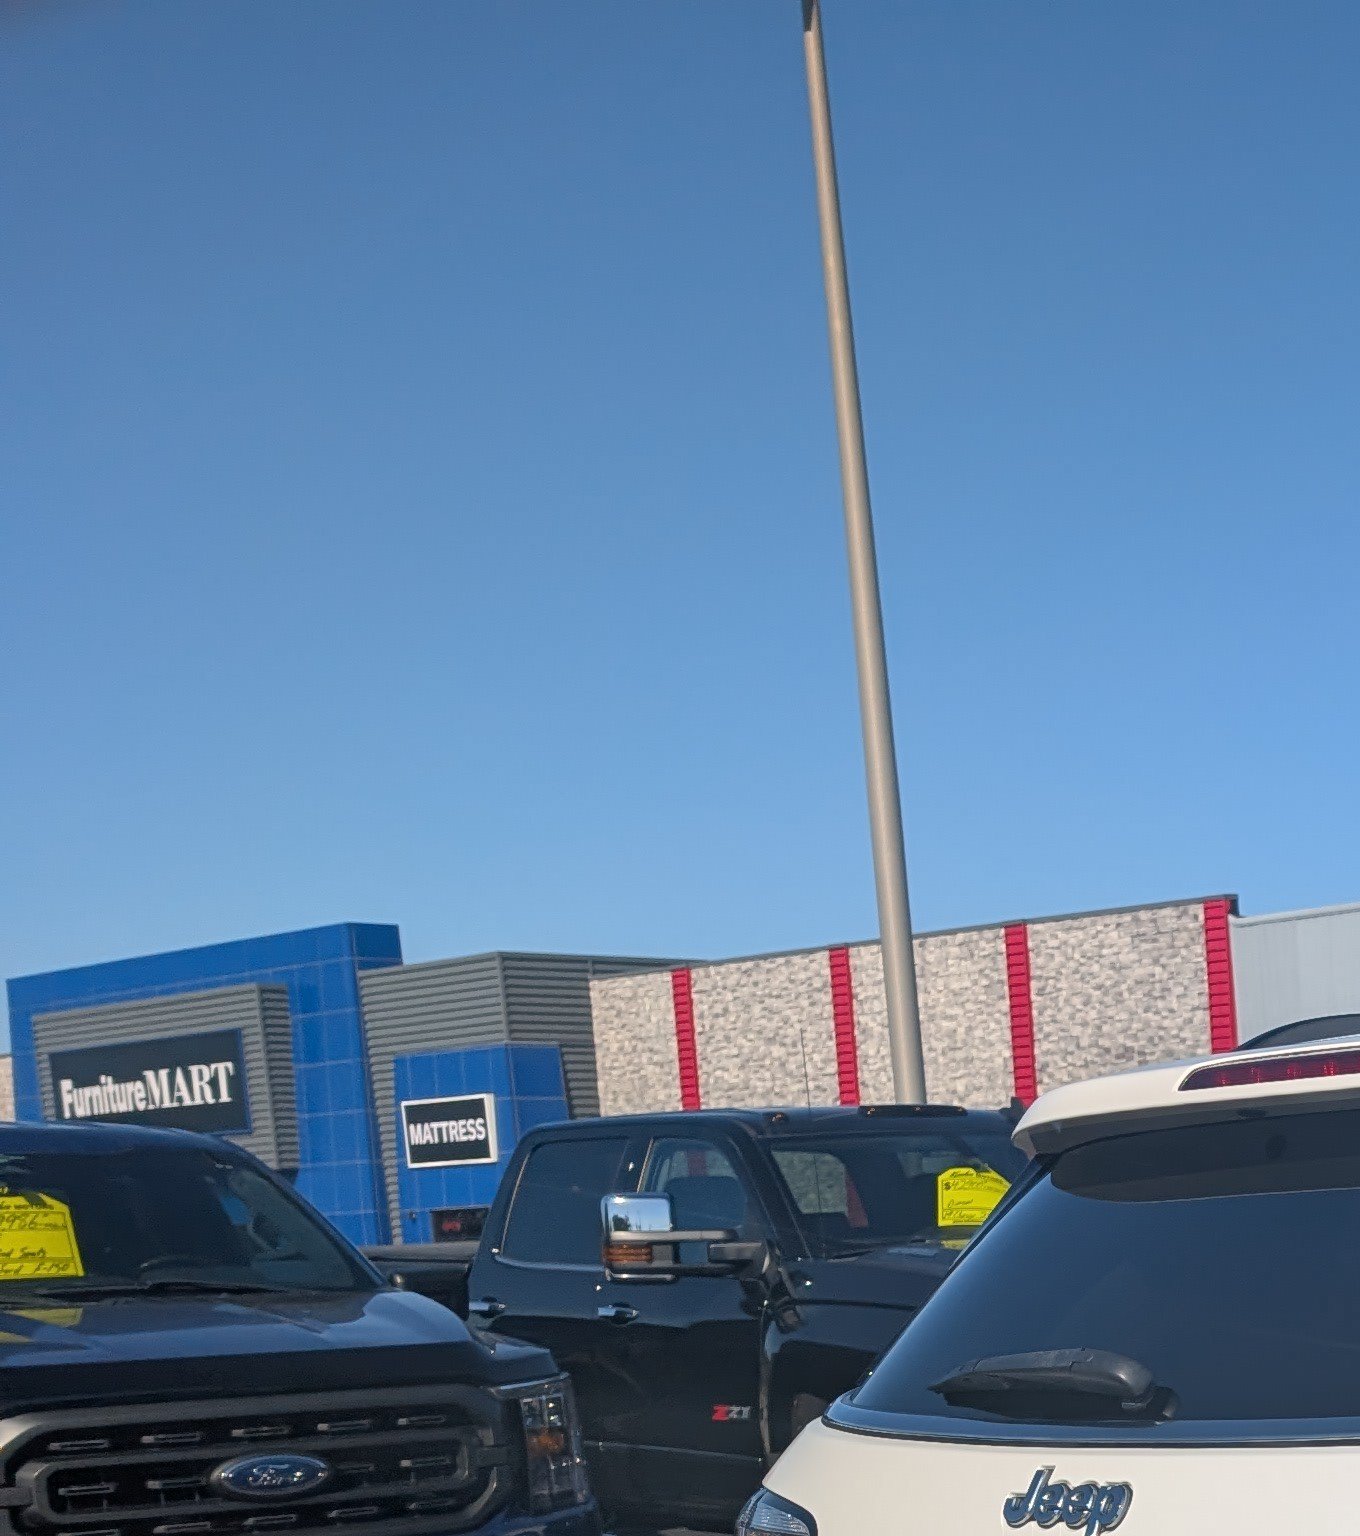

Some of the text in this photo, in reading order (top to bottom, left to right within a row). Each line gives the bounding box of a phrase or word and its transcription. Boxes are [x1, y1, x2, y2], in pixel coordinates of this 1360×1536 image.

[60, 1061, 235, 1119] FurnitureMART
[409, 1117, 486, 1146] MATTRESS
[712, 1404, 751, 1421] Z71
